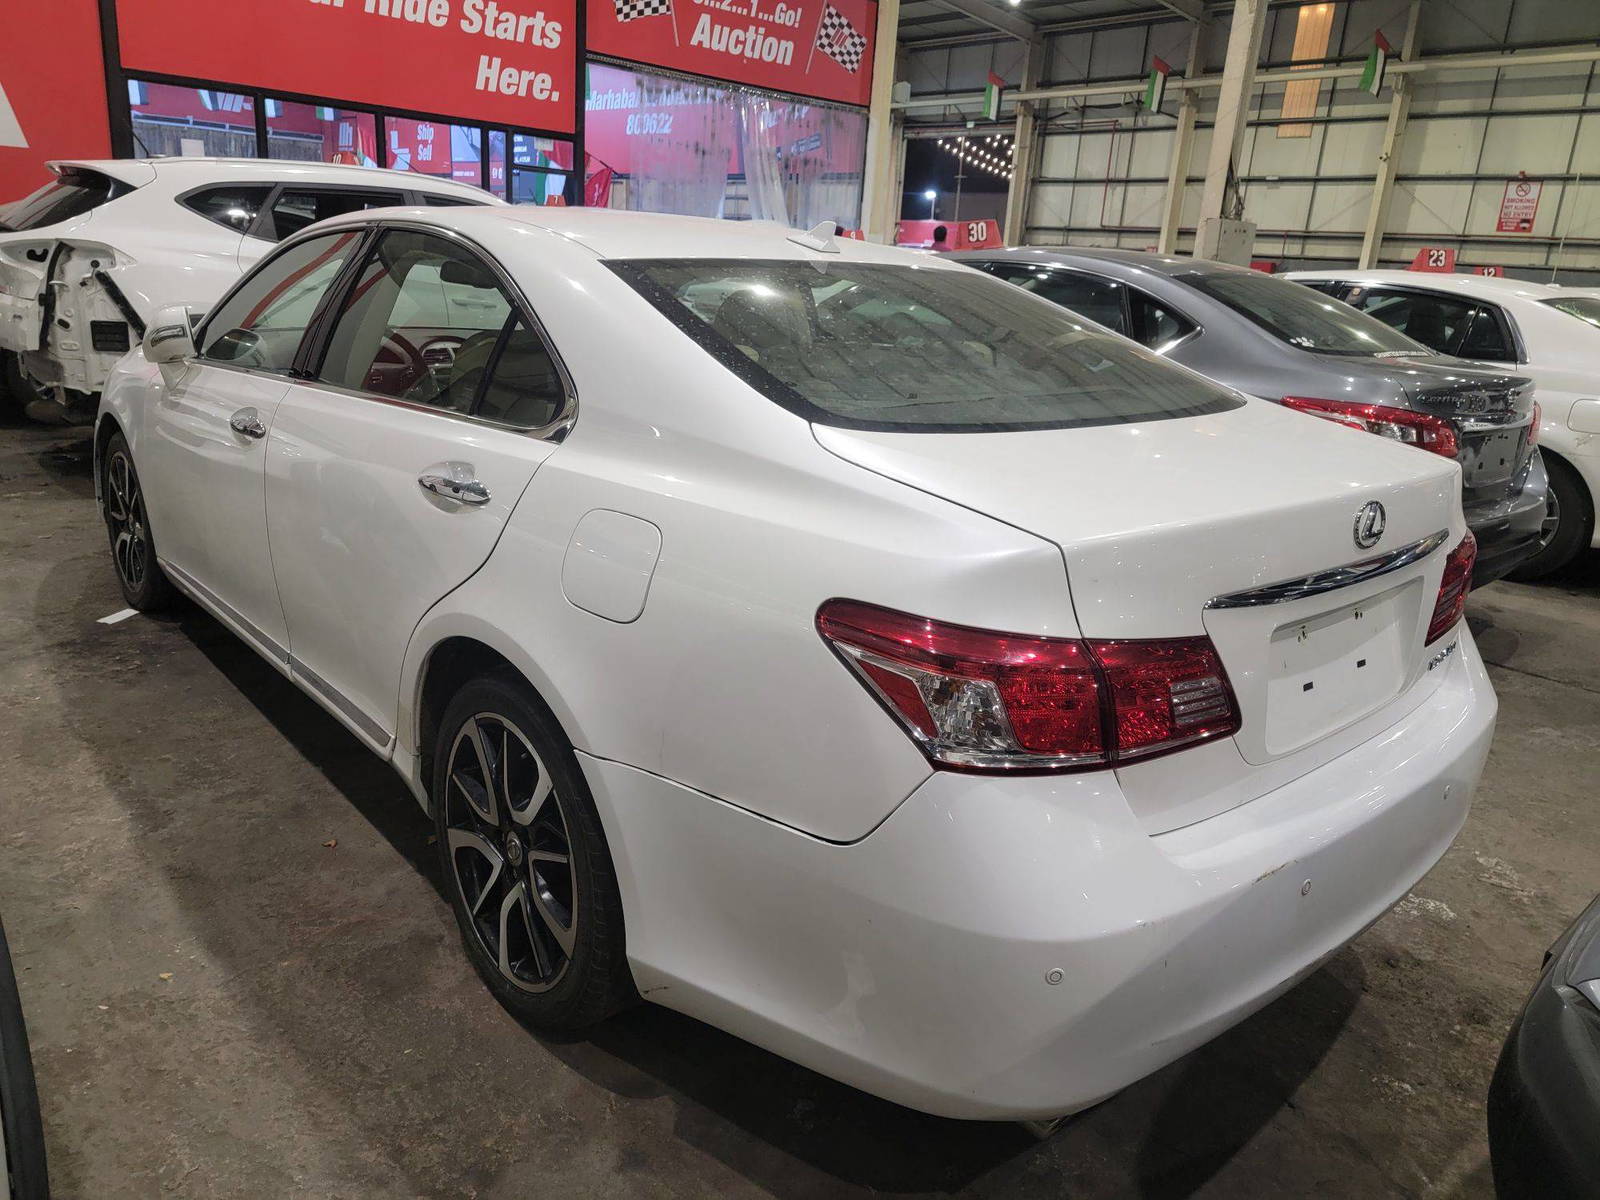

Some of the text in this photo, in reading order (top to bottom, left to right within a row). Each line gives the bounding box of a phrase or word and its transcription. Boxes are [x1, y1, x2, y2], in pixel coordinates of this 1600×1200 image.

[460, 0, 562, 49] Starts
[690, 13, 795, 65] Auction
[475, 55, 560, 102] Here.
[417, 124, 434, 143] Ship
[417, 144, 433, 161] Sell
[969, 222, 987, 242] 30
[1429, 250, 1446, 266] 23
[1483, 268, 1496, 277] 12
